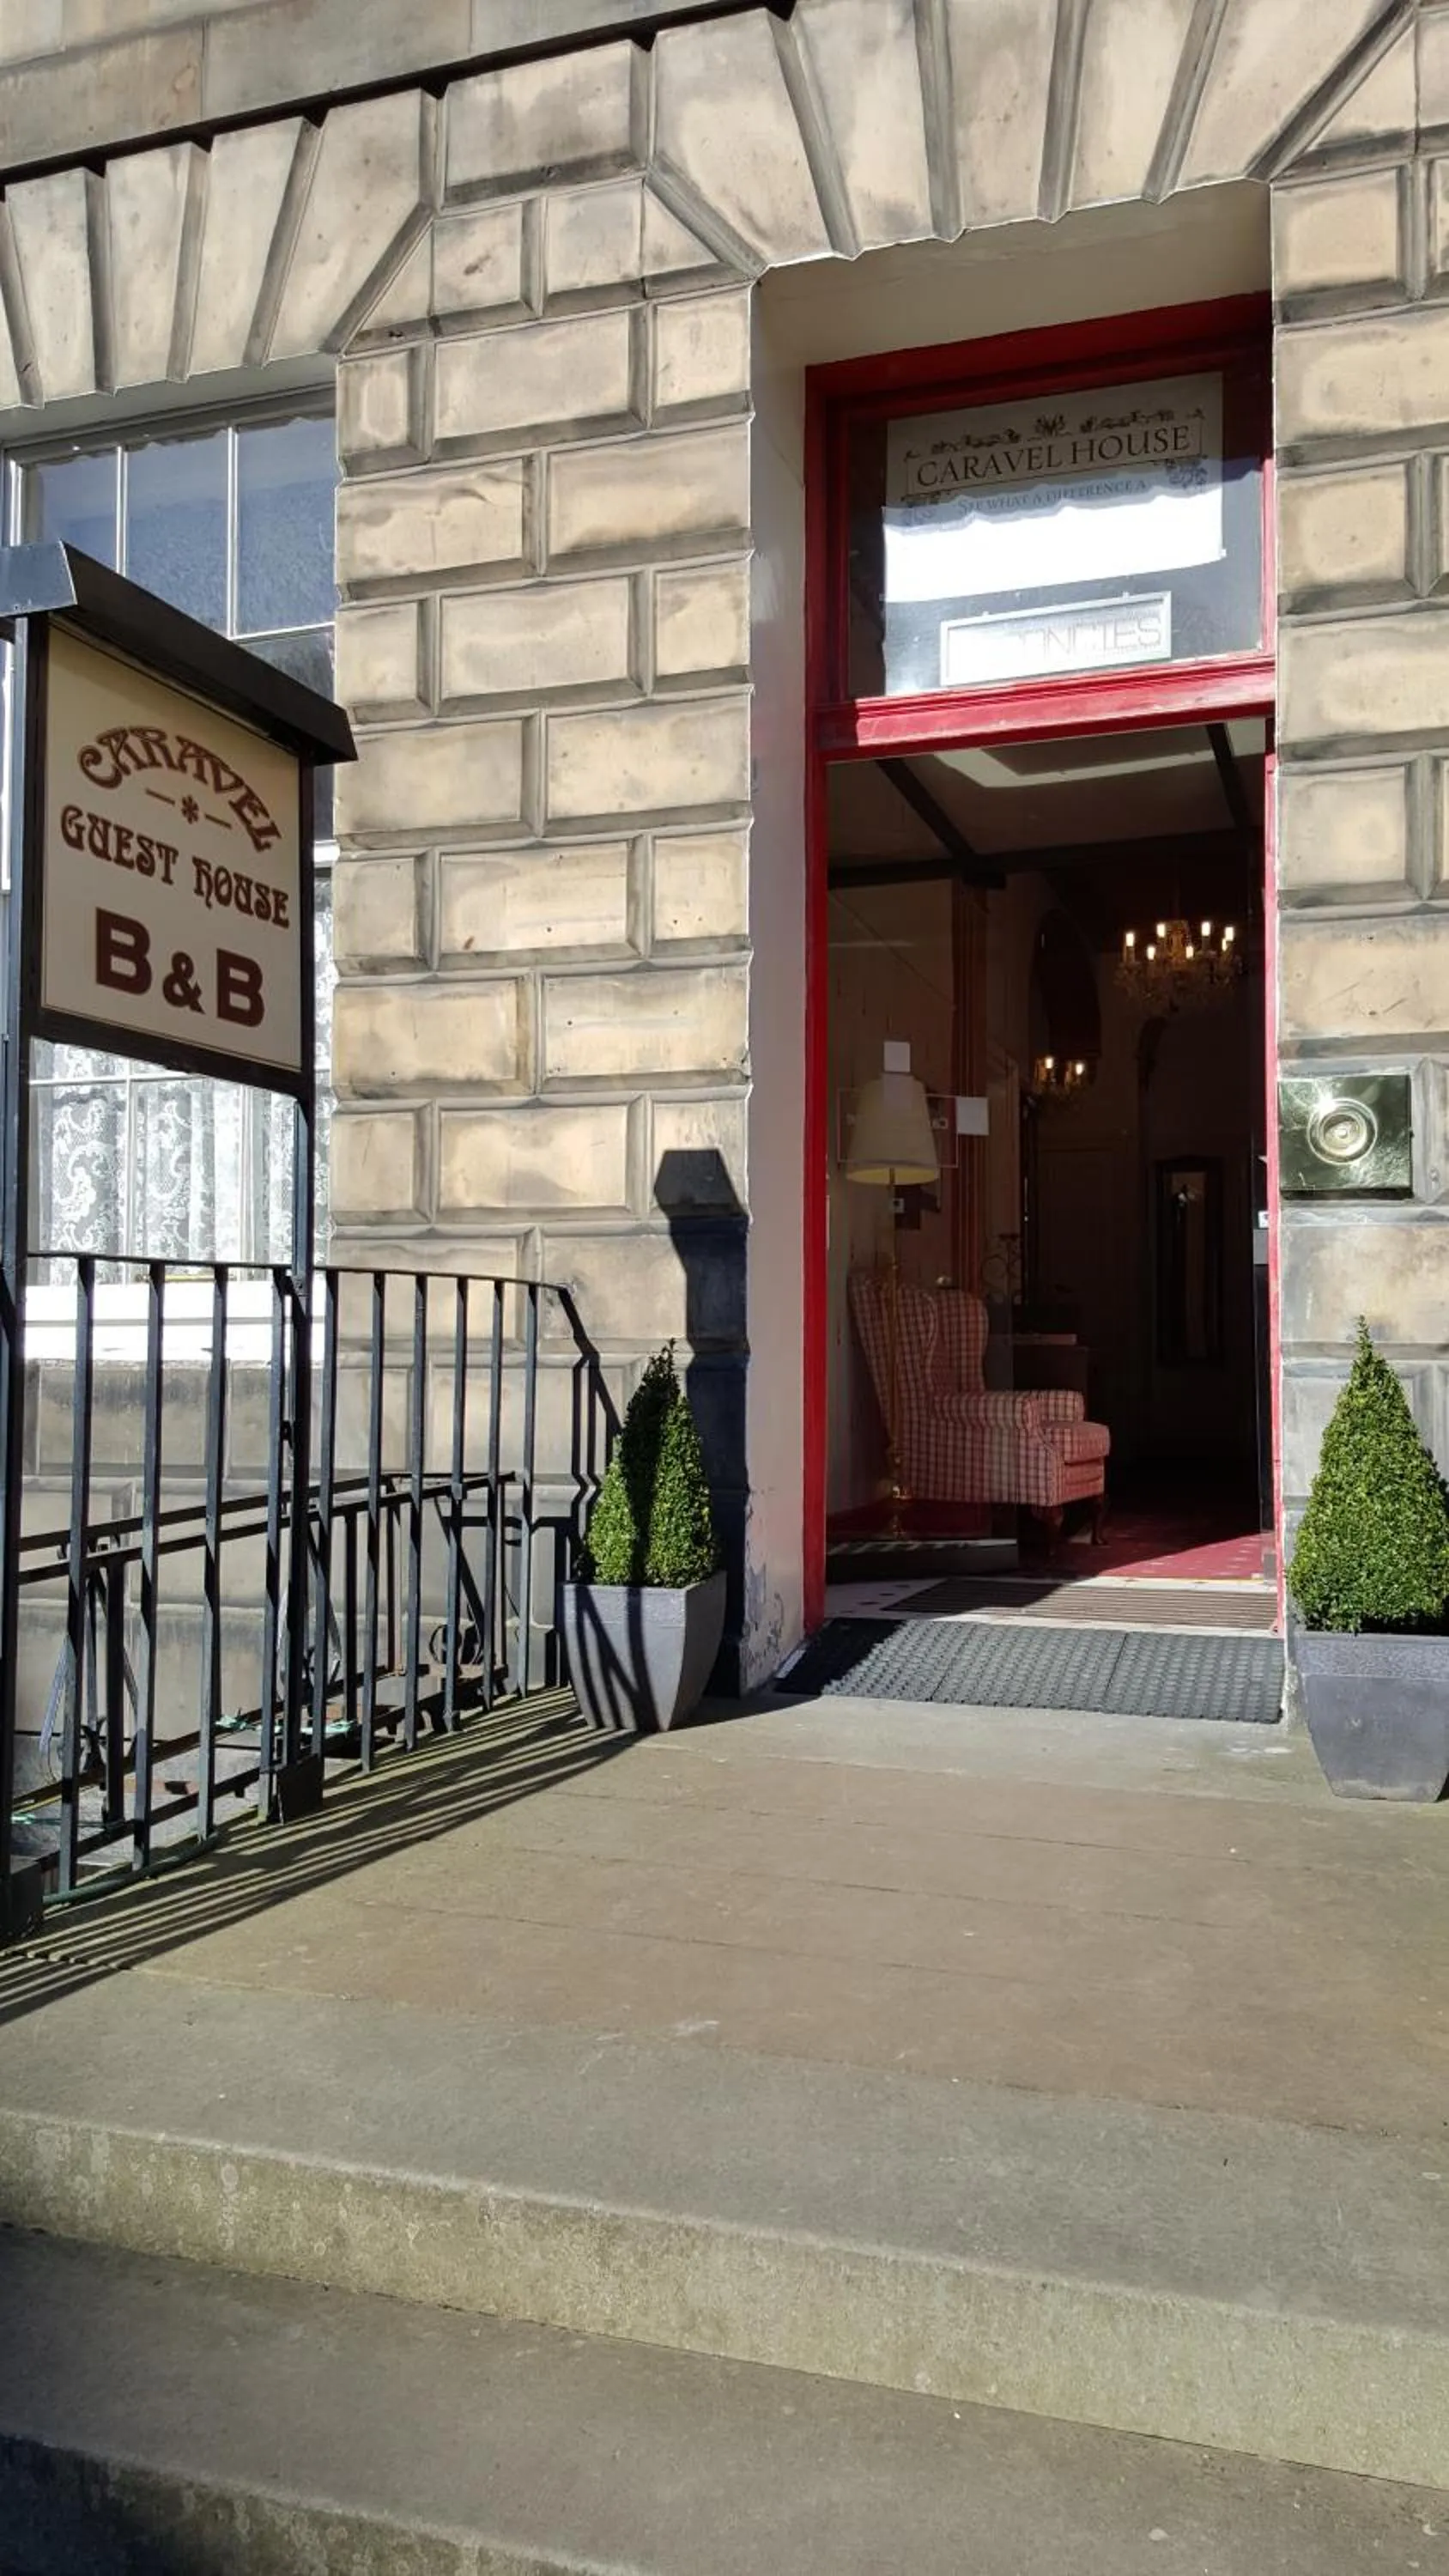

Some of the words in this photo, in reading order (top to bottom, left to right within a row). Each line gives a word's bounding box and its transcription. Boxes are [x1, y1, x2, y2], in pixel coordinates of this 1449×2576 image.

[917, 445, 1064, 488] CARAVEL
[1071, 424, 1191, 465] HOUSE
[985, 495, 1029, 510] WHAT
[1032, 492, 1043, 506] A
[1046, 481, 1133, 503] DIFFERENCE
[1134, 479, 1147, 491] A
[78, 726, 282, 853] CARAVEL
[60, 804, 179, 886] GUEST
[193, 855, 290, 929] HOUSE
